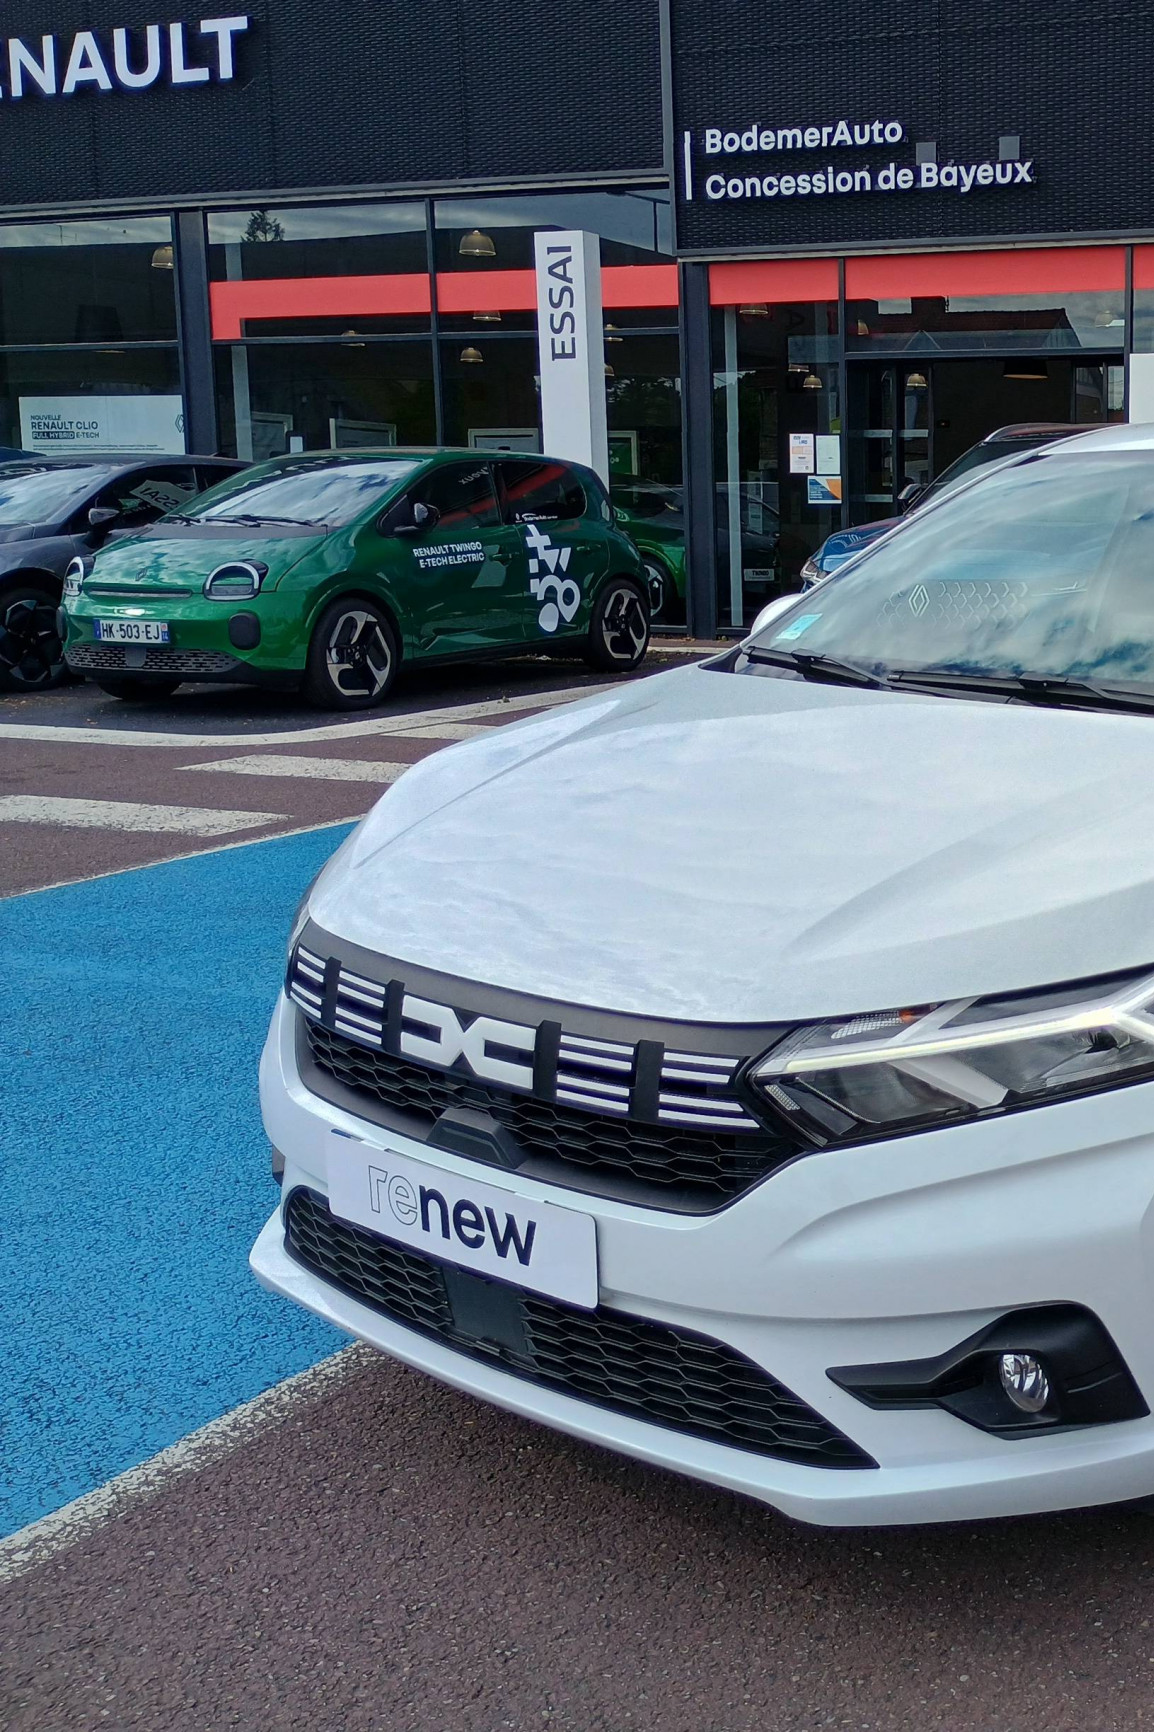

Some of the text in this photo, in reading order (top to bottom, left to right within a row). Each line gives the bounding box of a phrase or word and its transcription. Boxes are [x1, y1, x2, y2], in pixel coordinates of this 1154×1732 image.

[0, 16, 248, 98] NAULT
[705, 120, 903, 153] BodemerAuto
[705, 161, 1032, 199] Concession de Bayeux
[547, 246, 576, 361] ESSAI
[31, 421, 98, 430] RENAULT CLIO
[413, 542, 482, 557] RENAULT TWINGO
[420, 552, 485, 568] E-TECH ELECTRIC
[368, 1165, 537, 1266] renew
